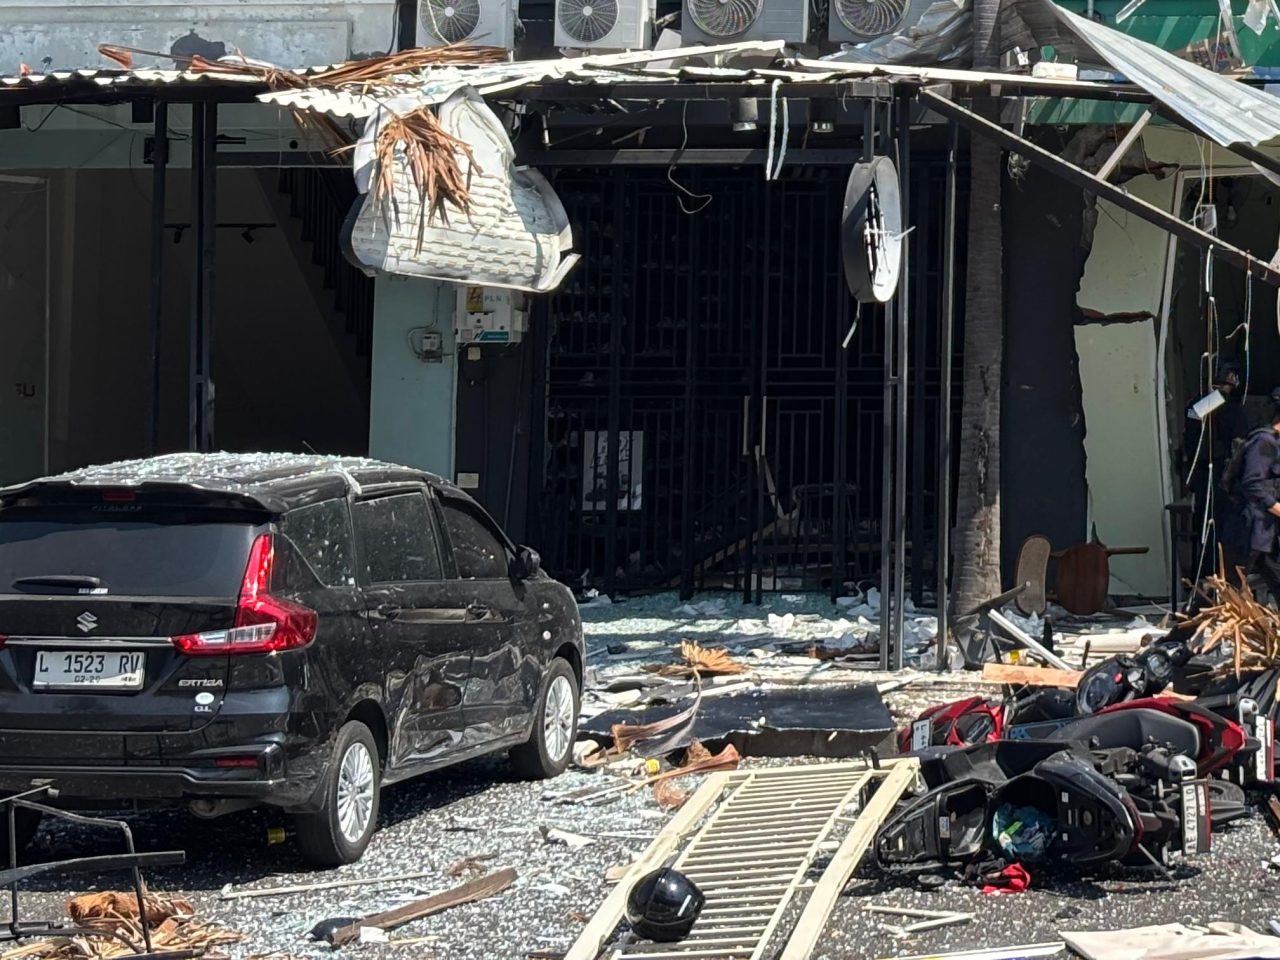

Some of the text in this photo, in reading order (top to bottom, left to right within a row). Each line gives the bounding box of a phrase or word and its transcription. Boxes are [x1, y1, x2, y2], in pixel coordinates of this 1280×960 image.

[39, 653, 140, 674] L 1523 RV
